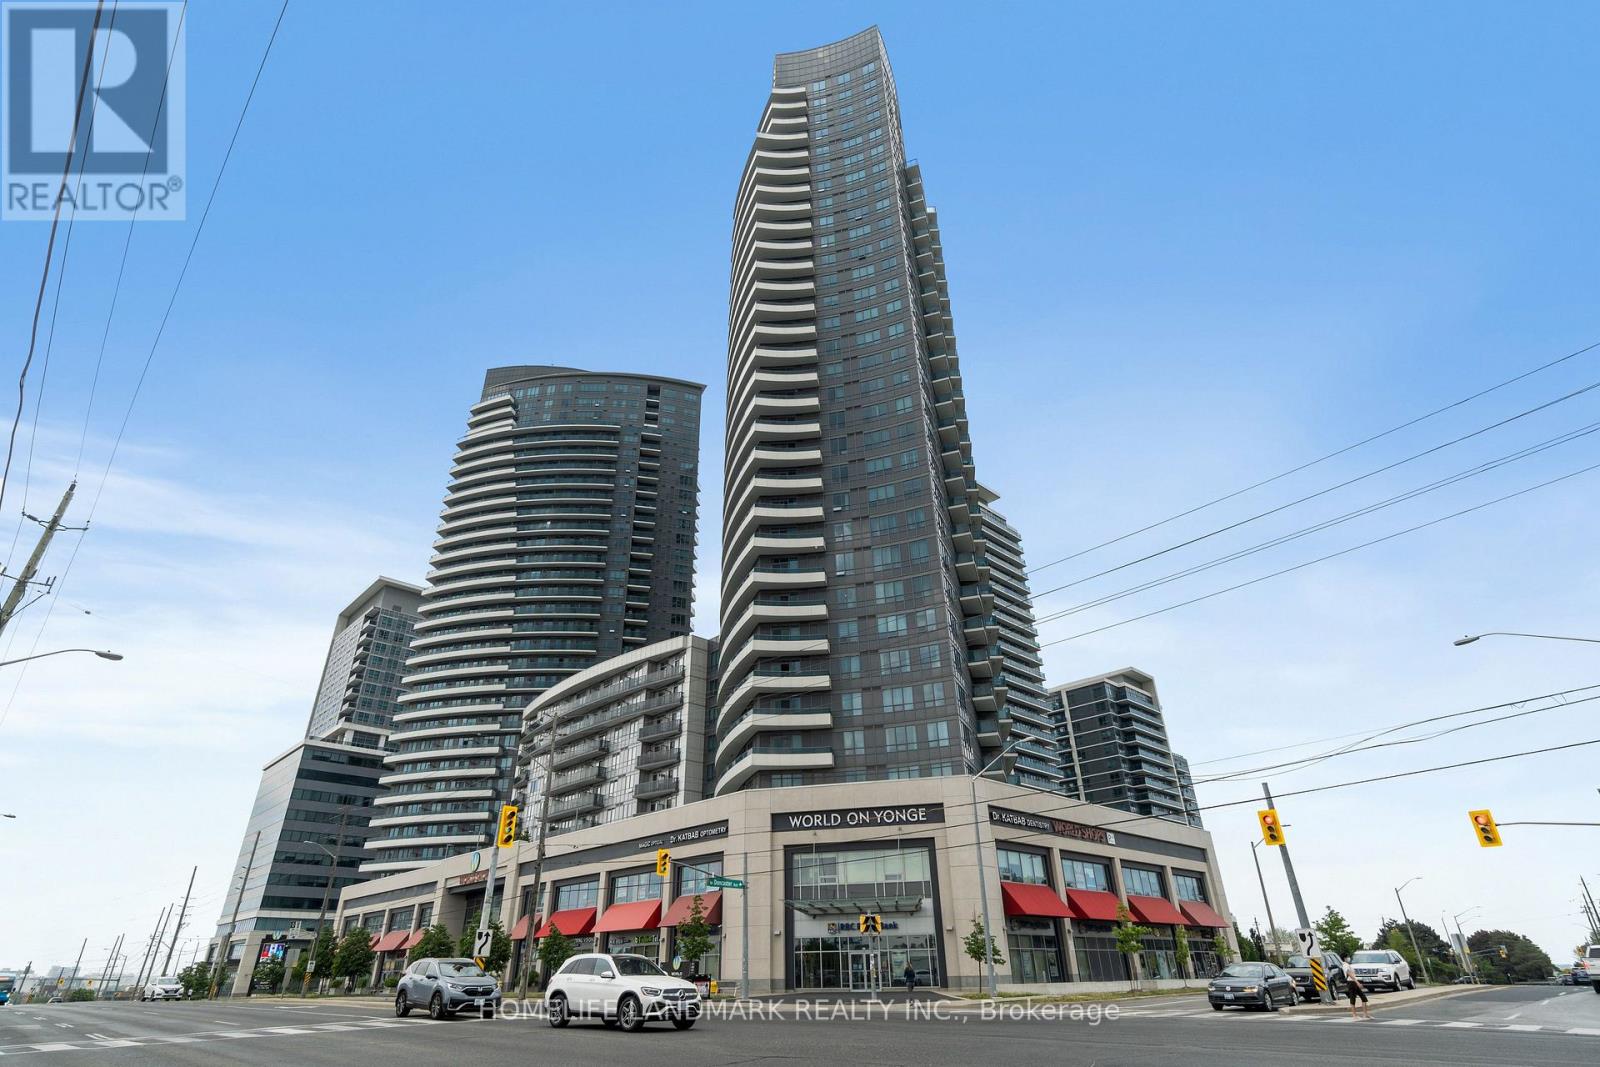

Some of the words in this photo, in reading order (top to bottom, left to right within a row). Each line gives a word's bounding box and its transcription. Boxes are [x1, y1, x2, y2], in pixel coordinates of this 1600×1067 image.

[788, 813, 841, 828] WORLD
[847, 811, 870, 825] ON
[874, 807, 927, 823] YONGE
[678, 830, 699, 841] KATBAB
[700, 826, 727, 837] OPTOMETRY
